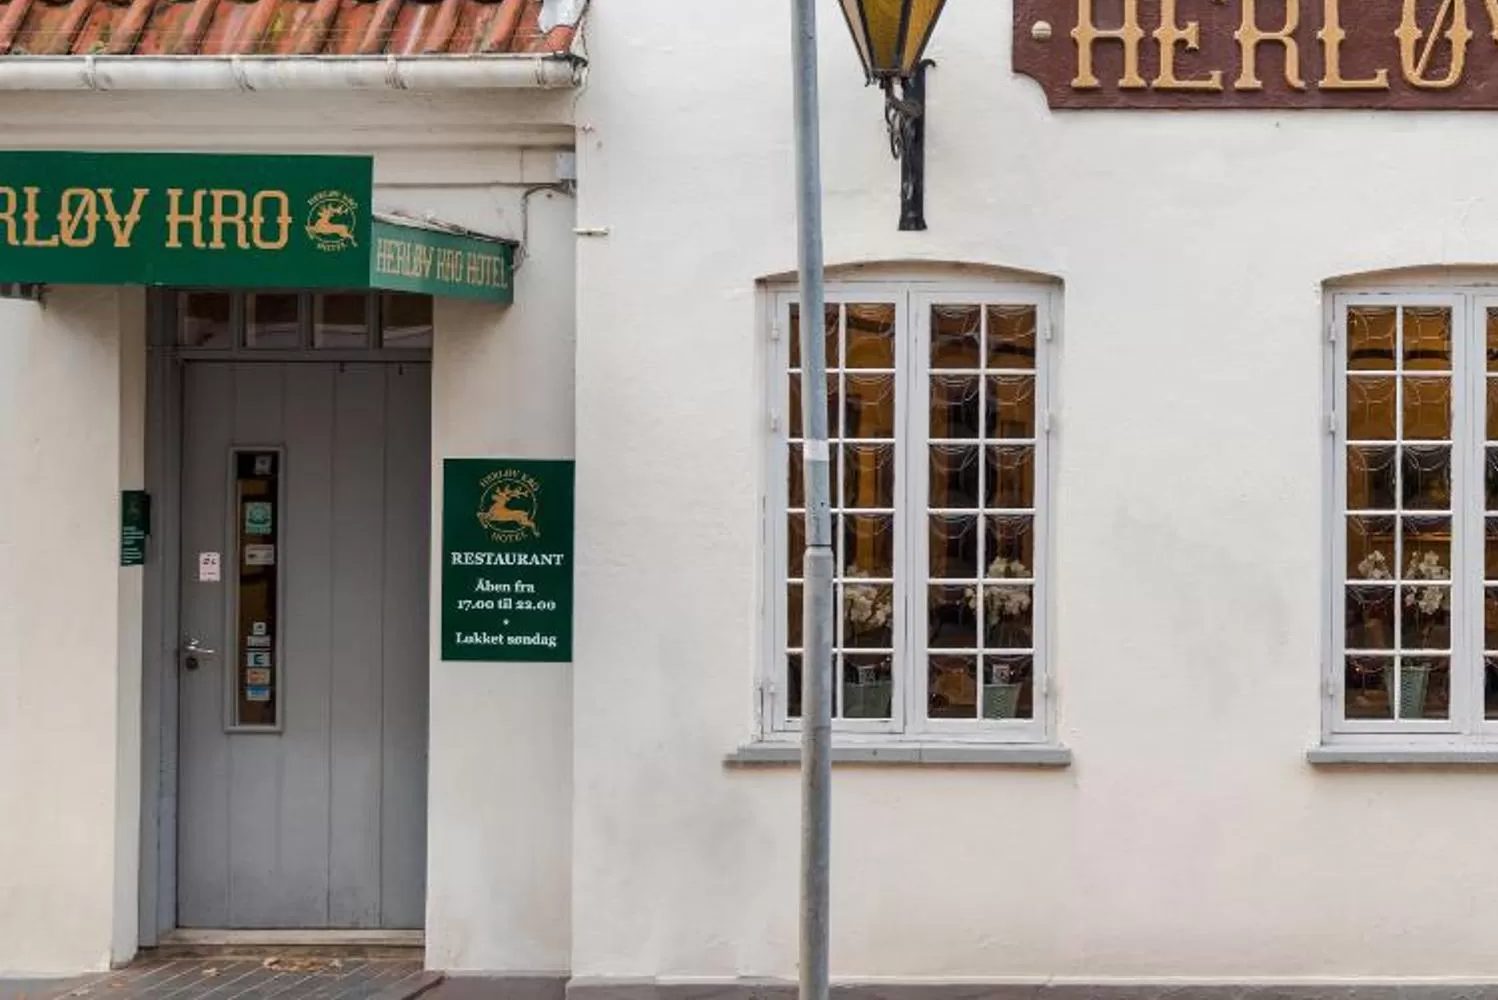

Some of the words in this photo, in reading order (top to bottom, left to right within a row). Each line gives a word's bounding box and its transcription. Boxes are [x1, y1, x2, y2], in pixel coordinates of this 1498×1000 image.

[164, 187, 293, 250] KRO
[450, 551, 565, 566] RESTAURANT
[474, 577, 511, 593] Åben
[514, 579, 536, 593] fra
[457, 599, 495, 612] 17.00
[497, 598, 512, 610] til
[515, 599, 557, 612] 22.00
[506, 631, 557, 648] søndag
